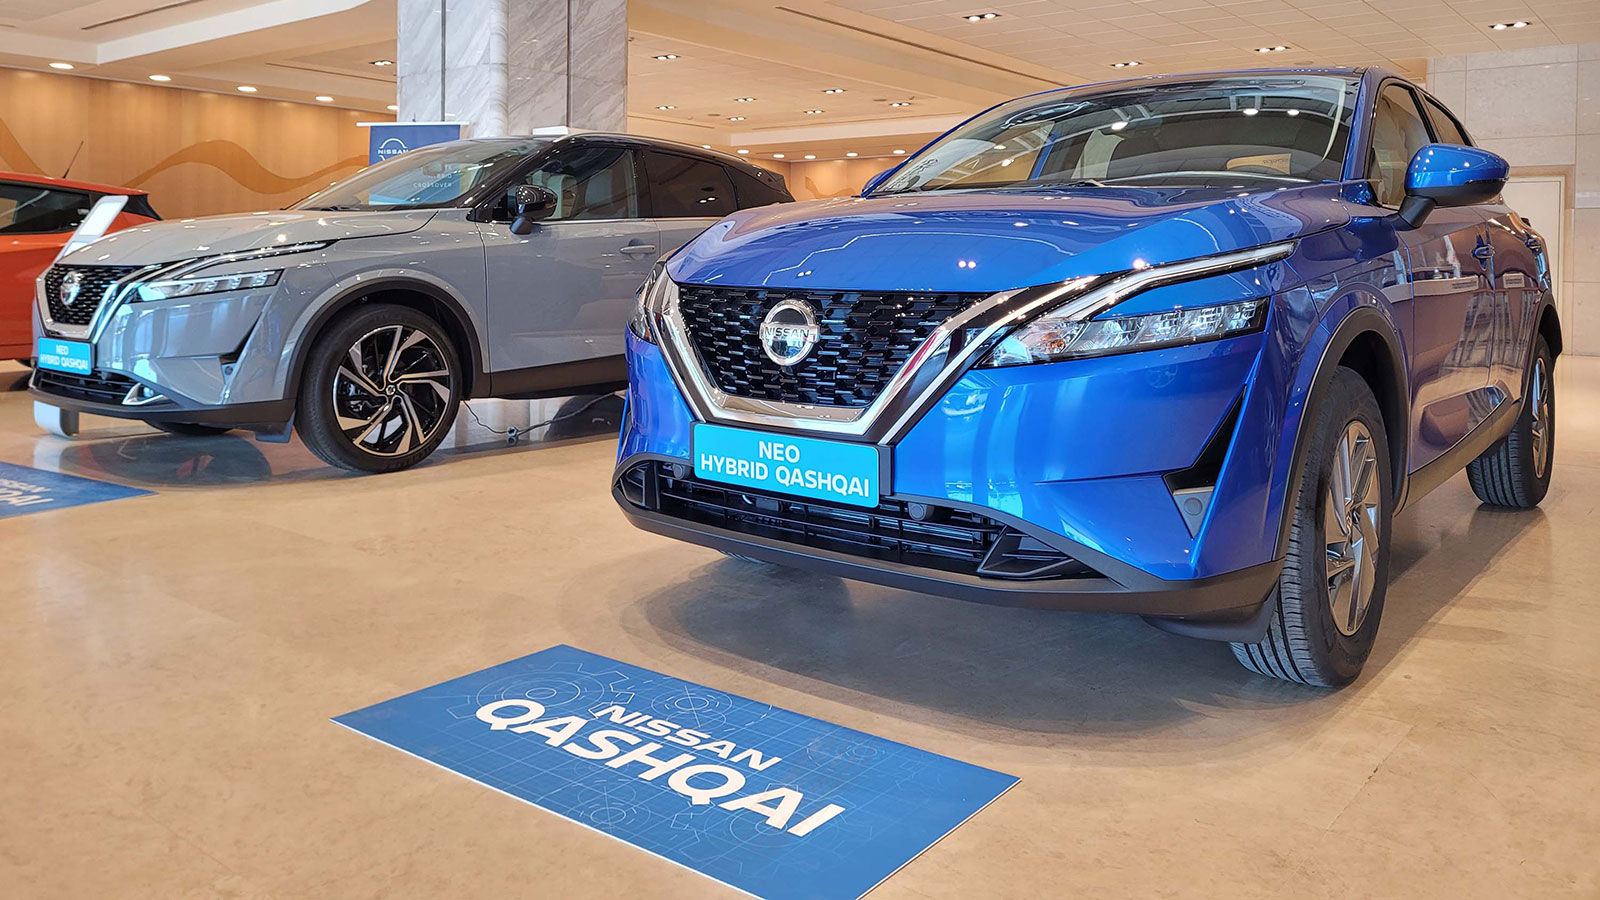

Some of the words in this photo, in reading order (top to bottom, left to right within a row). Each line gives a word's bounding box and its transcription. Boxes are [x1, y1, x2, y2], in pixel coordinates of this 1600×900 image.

[764, 326, 811, 339] NISSAN
[40, 353, 60, 366] HYBRID
[55, 344, 69, 356] NEO
[758, 440, 800, 464] NEO
[700, 453, 768, 481] HYBRID
[775, 465, 870, 498] QASHQAI
[594, 703, 781, 771] NISSAN
[475, 698, 846, 837] QASHQAI
